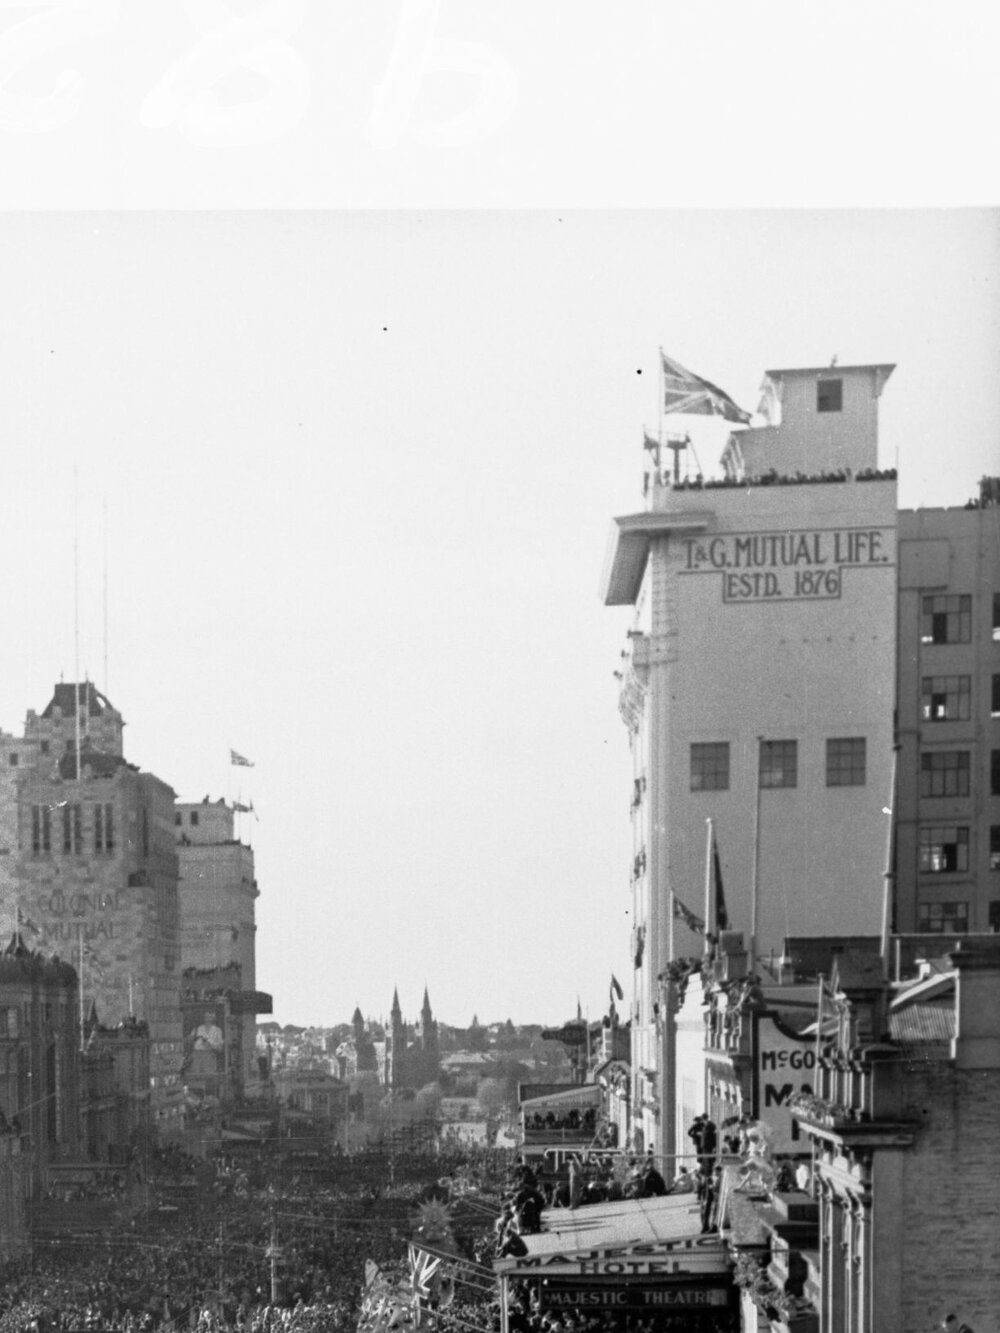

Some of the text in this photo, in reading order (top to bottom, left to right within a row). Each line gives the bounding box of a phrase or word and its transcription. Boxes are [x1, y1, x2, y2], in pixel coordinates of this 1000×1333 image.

[734, 534, 828, 568] MUTUAL
[834, 531, 889, 563] LIFE.
[727, 569, 839, 597] ESTD. 1876
[43, 920, 118, 941] MUTUAL
[762, 1049, 816, 1071] McGO
[516, 1236, 720, 1269] MAJESTIC
[580, 1261, 690, 1275] HOTEL
[549, 1291, 628, 1305] MAJESTIC
